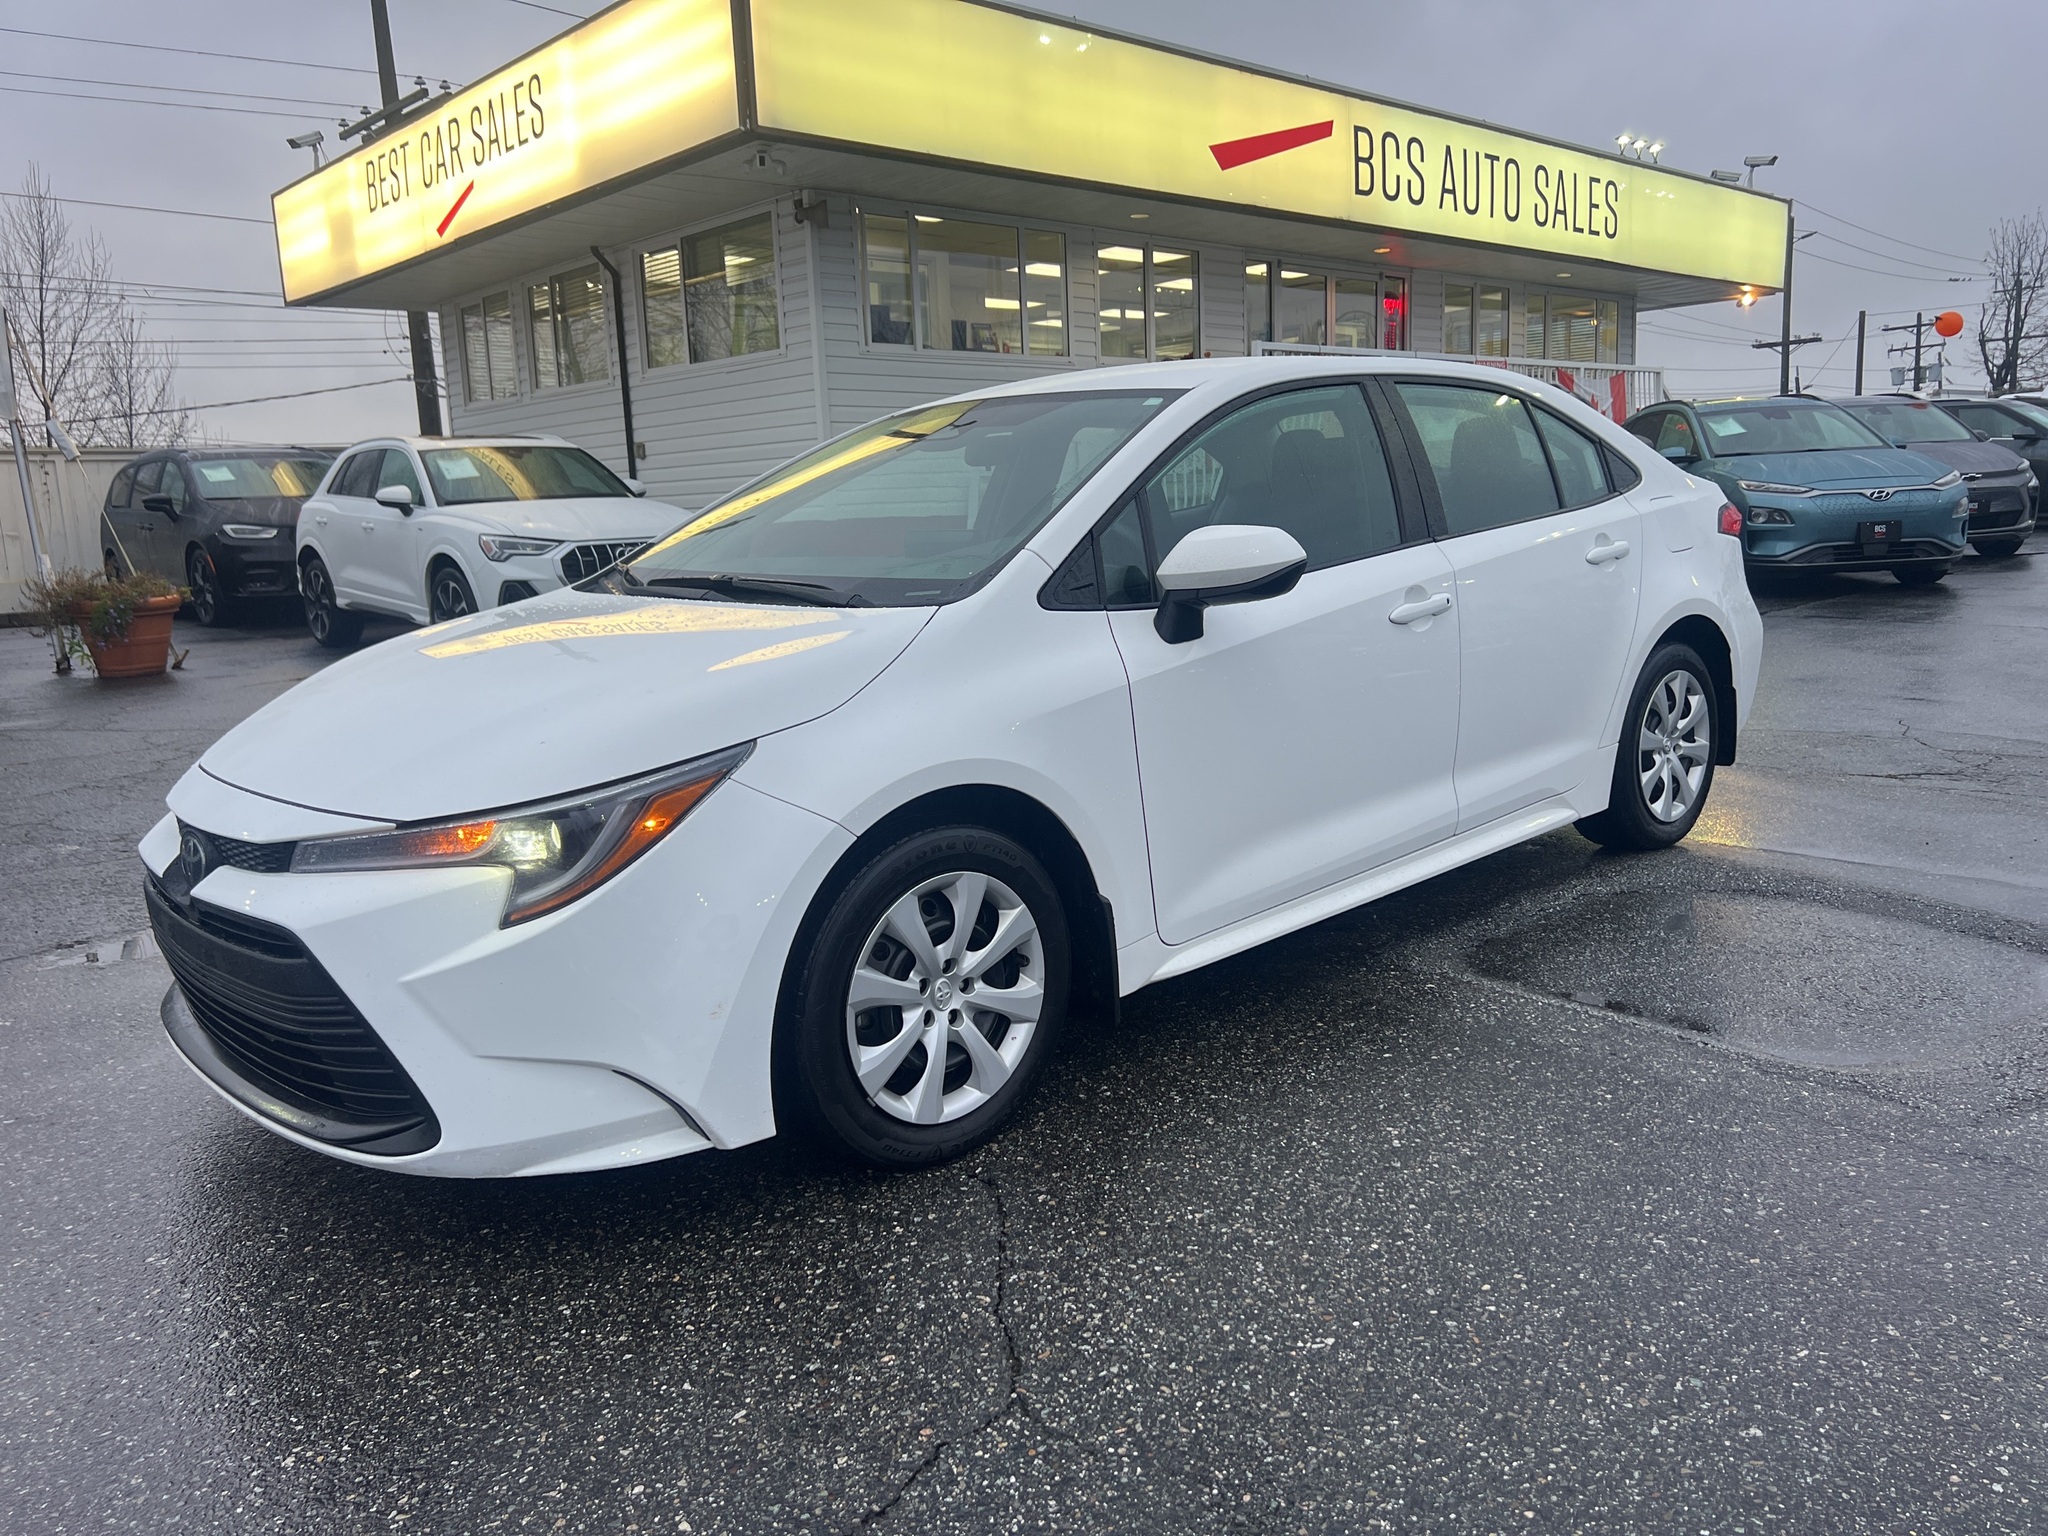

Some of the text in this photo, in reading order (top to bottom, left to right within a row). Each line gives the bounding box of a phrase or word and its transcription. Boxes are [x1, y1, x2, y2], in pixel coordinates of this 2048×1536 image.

[366, 74, 544, 213] BEST CAR SALES
[1353, 125, 1619, 239] BCS AUTO SALES
[1874, 524, 1887, 533] BCS
